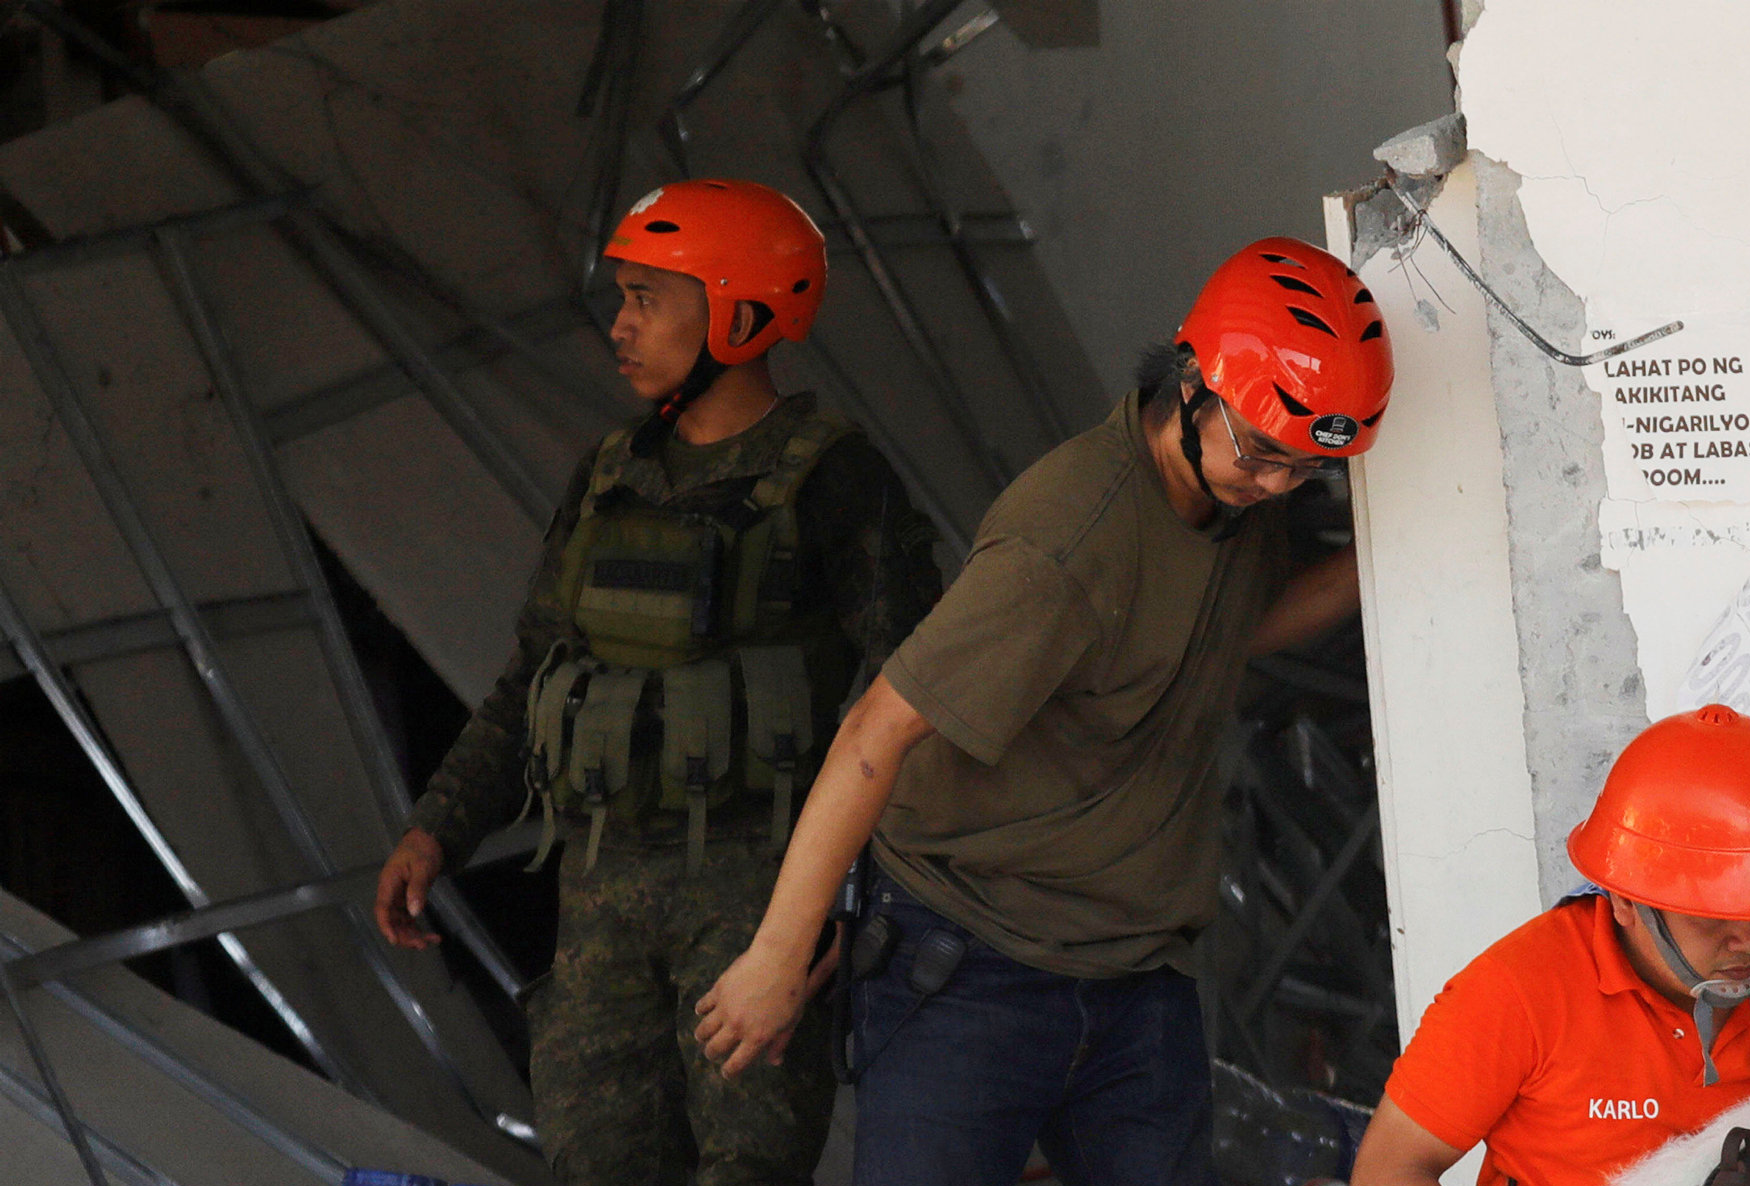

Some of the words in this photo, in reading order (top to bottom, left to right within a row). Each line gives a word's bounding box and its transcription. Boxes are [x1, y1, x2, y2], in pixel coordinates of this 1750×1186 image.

[1604, 359, 1672, 378] LAHAT
[1678, 359, 1706, 376] PO
[1713, 357, 1743, 375] NG
[1615, 384, 1726, 404] AKIKITANG
[1622, 413, 1750, 434] -NIGARILYO
[1660, 442, 1687, 460] AT
[1588, 1098, 1659, 1119] KARLO
